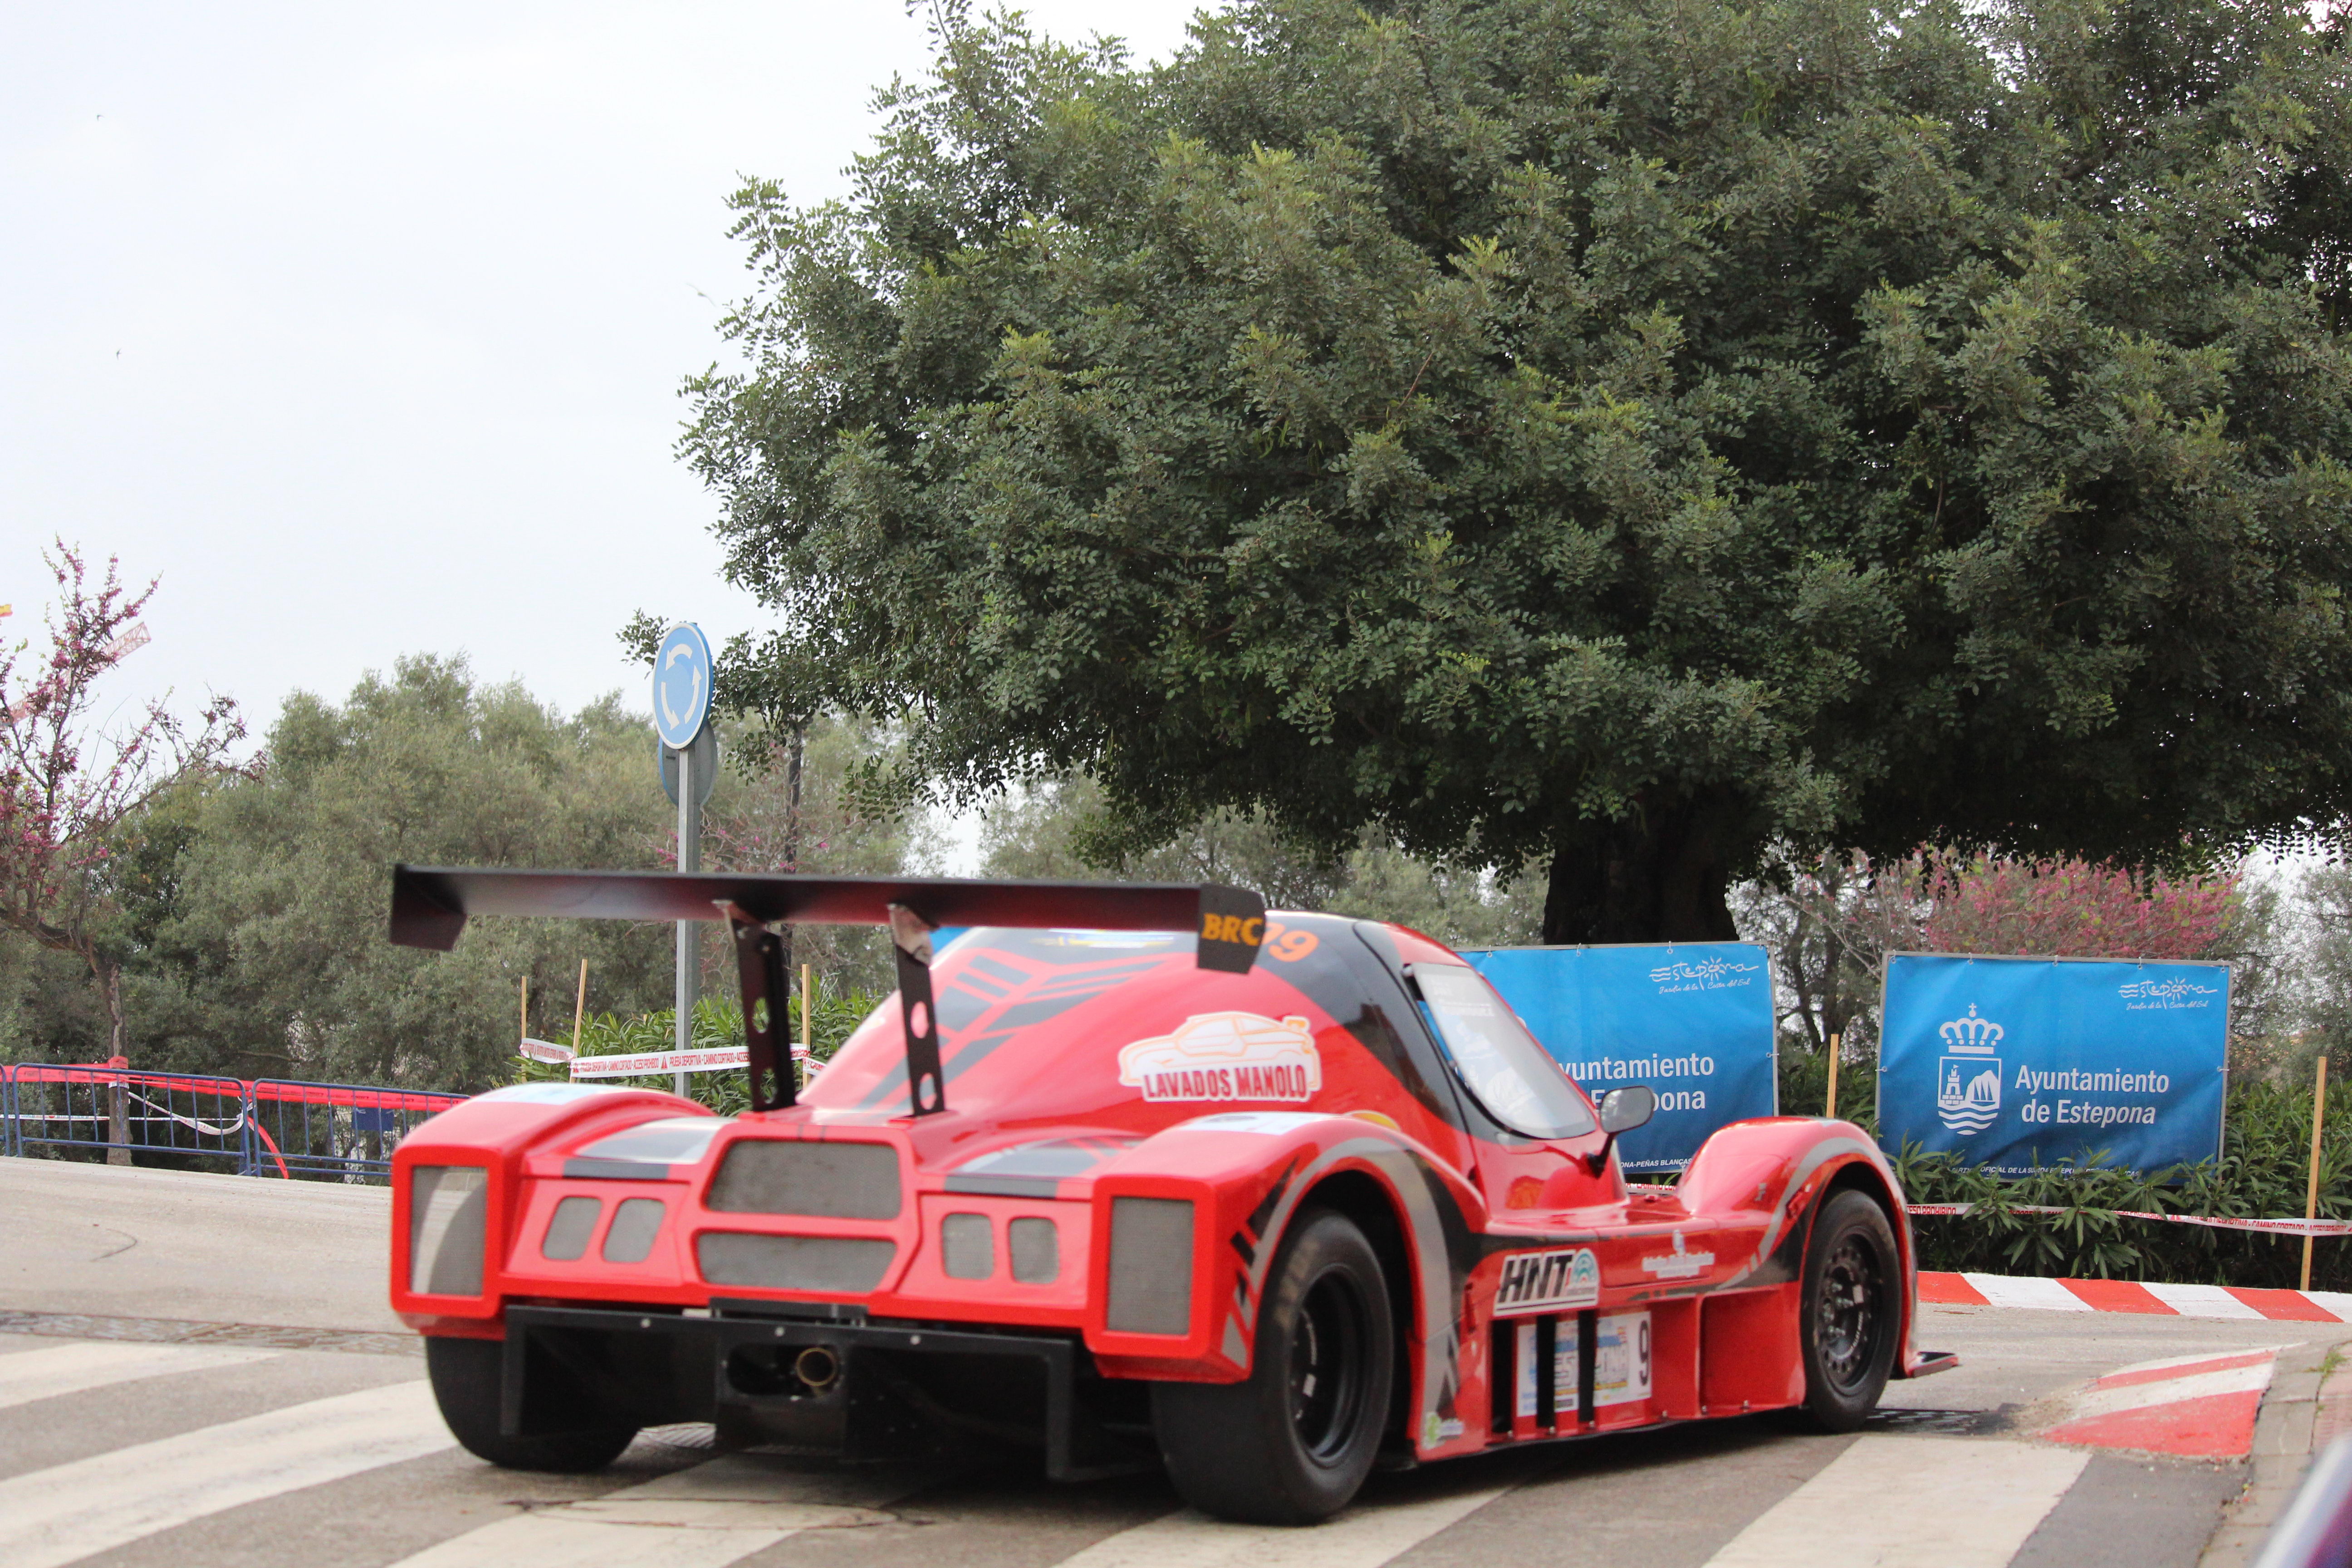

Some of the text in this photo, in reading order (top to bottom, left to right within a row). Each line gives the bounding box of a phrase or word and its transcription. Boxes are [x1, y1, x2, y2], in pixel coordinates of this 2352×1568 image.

[1201, 913, 1263, 946] BRC
[1707, 981, 1725, 990] Costa
[1726, 979, 1737, 988] del
[1737, 978, 1751, 986] Sol
[681, 1054, 701, 1066] DEPORTIVA
[704, 1053, 717, 1065] CAMINO
[718, 1052, 735, 1064] CORTADO
[1558, 1053, 1714, 1081] yuntamiento
[1143, 1064, 1308, 1098] LAVADOS MANOLO
[2014, 1065, 2170, 1095] Ayuntamiento
[2021, 1098, 2156, 1128] de Estepona
[1660, 1157, 1693, 1166] BLANCAS
[1498, 1254, 1573, 1303] HNT
[1639, 1319, 1649, 1387] 9
